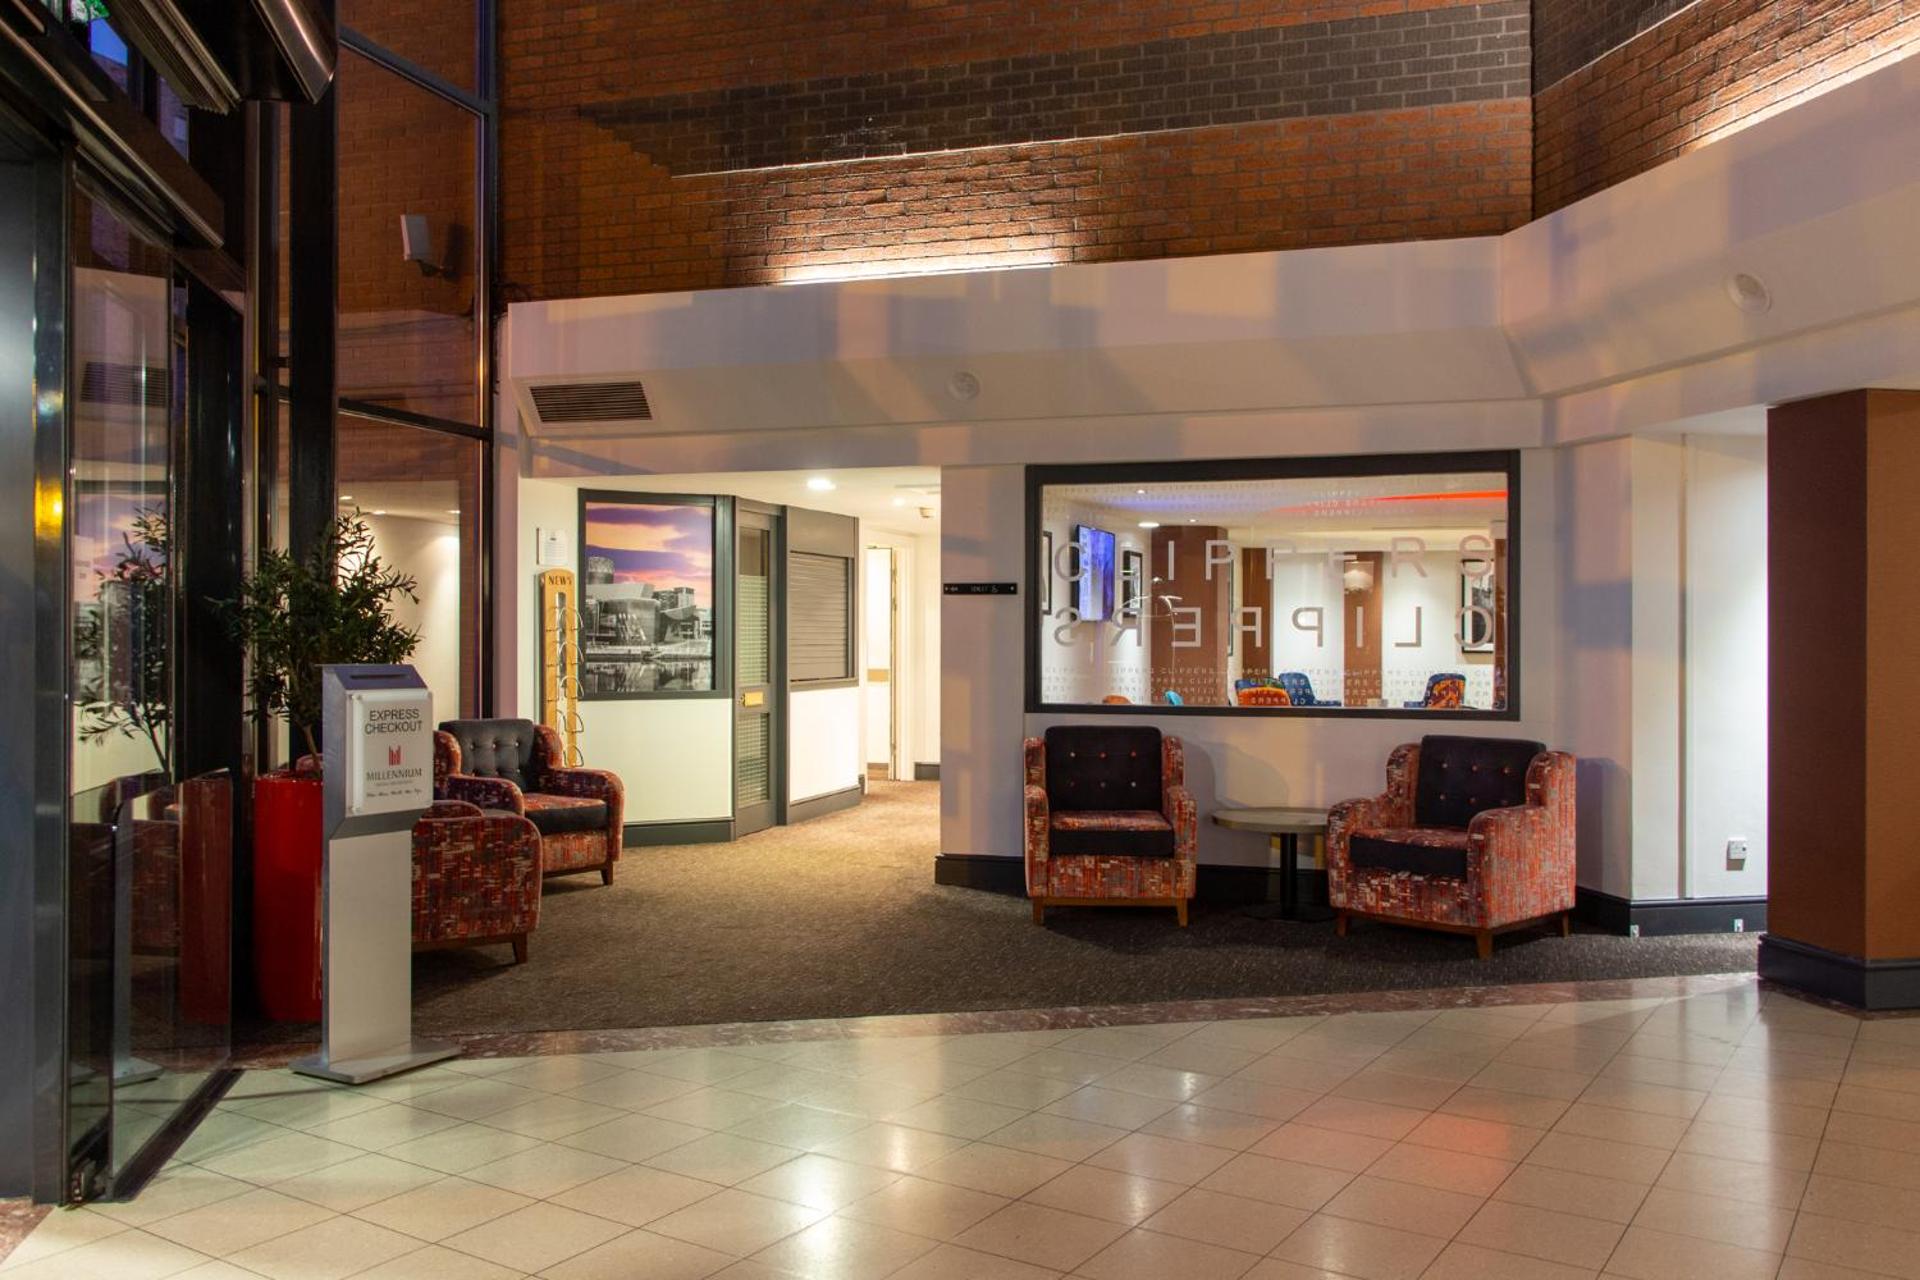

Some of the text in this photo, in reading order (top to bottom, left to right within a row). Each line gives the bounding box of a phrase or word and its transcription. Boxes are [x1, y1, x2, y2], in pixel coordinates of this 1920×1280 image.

[548, 575, 572, 586] NEWS
[369, 709, 420, 721] EXPRESS
[365, 721, 422, 734] CHECKOUT
[366, 768, 422, 781] MILLENNIUM
